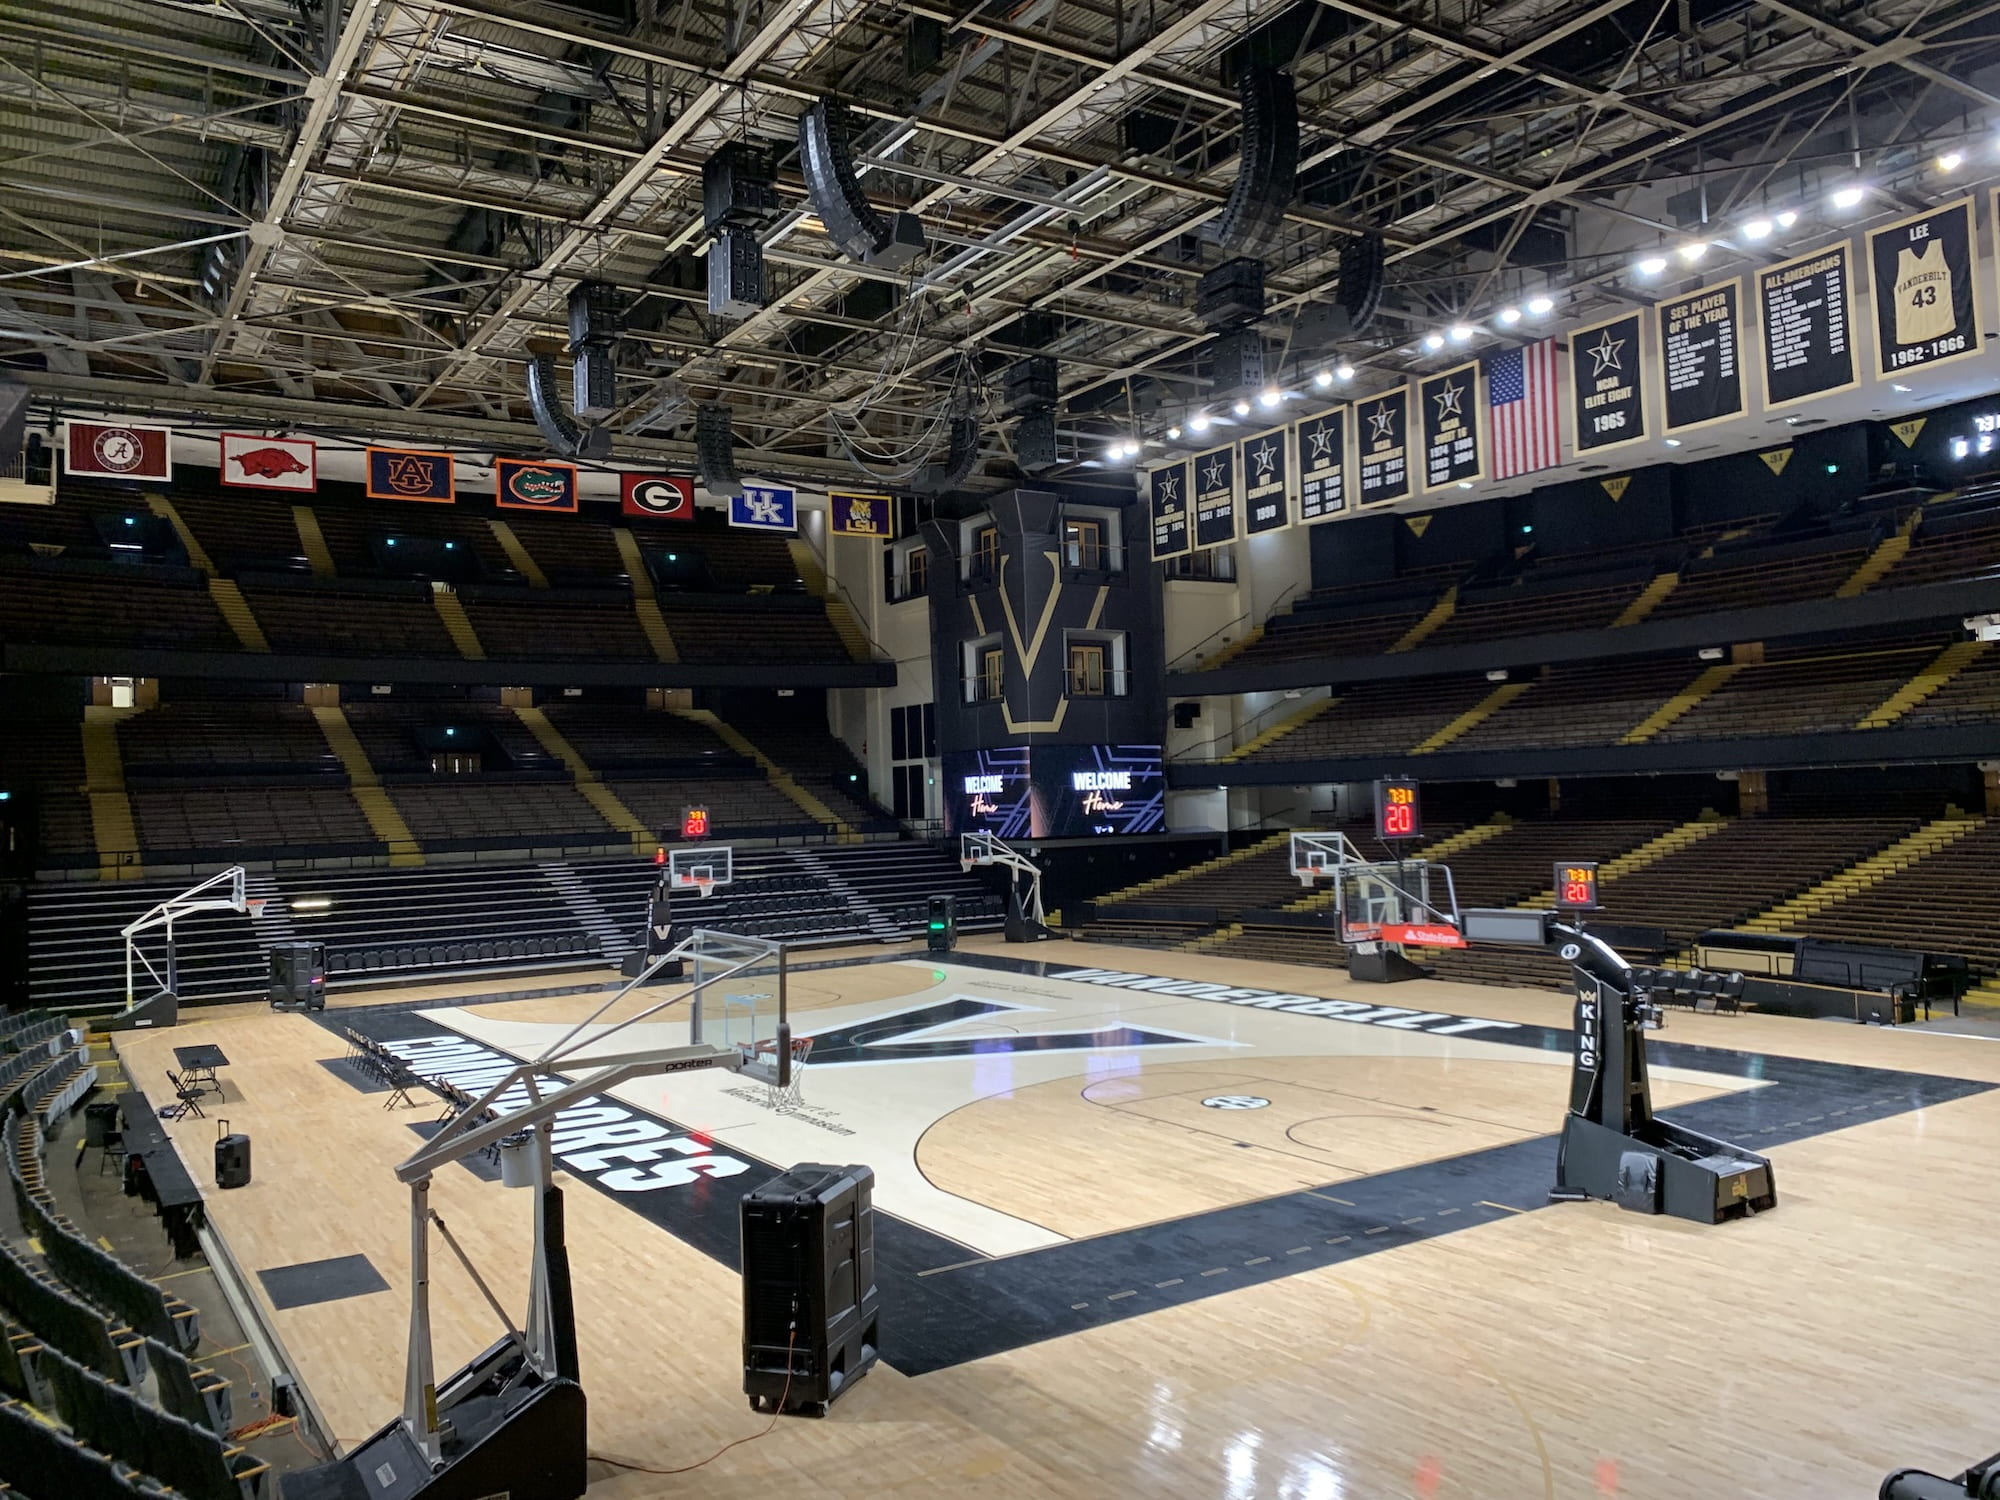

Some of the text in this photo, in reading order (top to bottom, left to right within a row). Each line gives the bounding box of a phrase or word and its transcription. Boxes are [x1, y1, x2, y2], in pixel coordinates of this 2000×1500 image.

[1909, 223, 1930, 242] LEE
[1765, 254, 1841, 290] ALL-AMERICANS
[1898, 271, 1947, 294] VANDERBILT
[1670, 293, 1726, 320] SEC PLAYER
[1912, 286, 1936, 309] 43
[1669, 320, 1682, 334] OF
[1684, 315, 1702, 330] THE
[1703, 306, 1729, 324] YEAR
[1891, 335, 1965, 367] 1962-1966
[1596, 376, 1619, 392] NCAA
[1584, 386, 1632, 409] ELITE EIGHT
[1593, 411, 1626, 433] 1965
[1362, 446, 1404, 466] TOURNAMENT
[1247, 481, 1283, 500] CHAMPIONS
[1198, 494, 1231, 512] CHAMPIONS
[845, 519, 877, 533] LSU
[1155, 510, 1185, 526] CHAMPIONS
[965, 775, 1004, 794] WELCOME
[1073, 771, 1132, 791] WELCOME
[971, 793, 999, 817] Home
[1083, 790, 1124, 815] Home
[1388, 788, 1414, 804] 7:31
[687, 819, 705, 834] 20
[1387, 805, 1410, 832] 20
[1567, 868, 1593, 882] 7:31
[1567, 883, 1587, 901] 20
[653, 924, 673, 940] V
[1047, 969, 1523, 1034] VANDERBILT
[1580, 1004, 1595, 1066] KING
